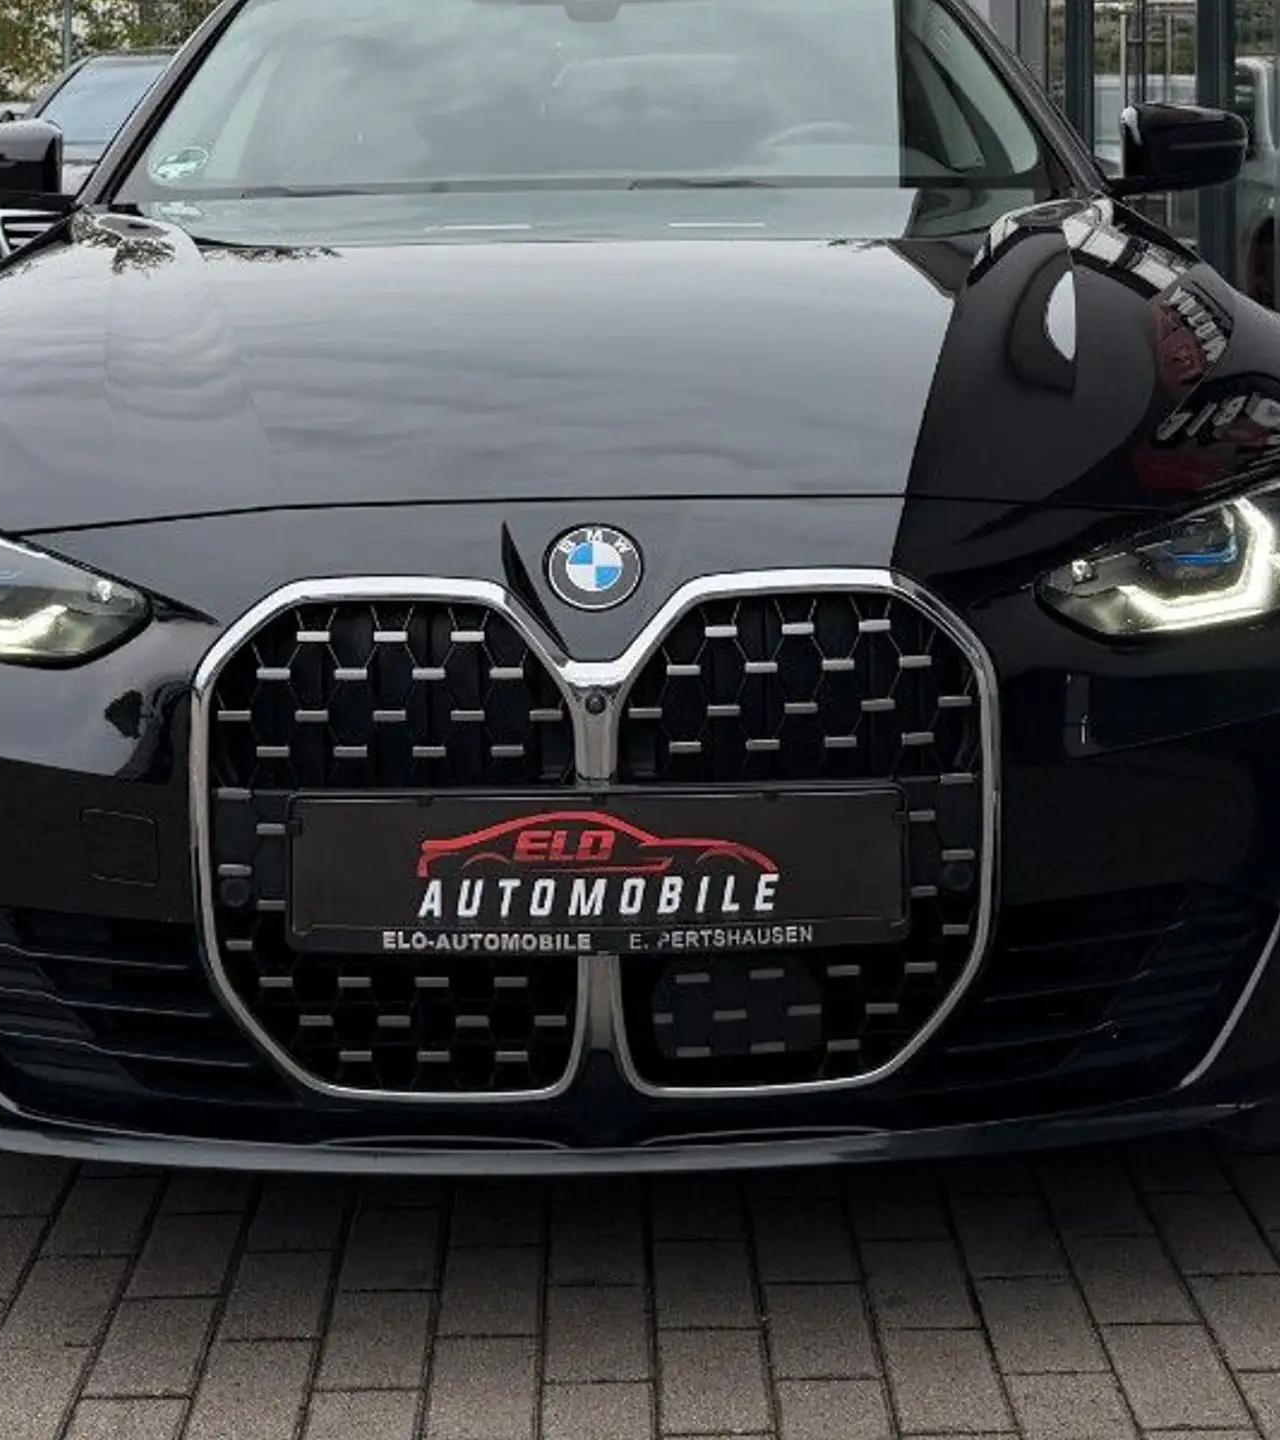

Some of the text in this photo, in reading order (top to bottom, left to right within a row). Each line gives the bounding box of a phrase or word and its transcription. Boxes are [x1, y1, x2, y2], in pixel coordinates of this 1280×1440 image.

[555, 527, 636, 555] BMW
[513, 829, 616, 861] ELO
[418, 873, 781, 919] AUTOMOBILE
[382, 930, 592, 952] ELO-AUTOMOBILE
